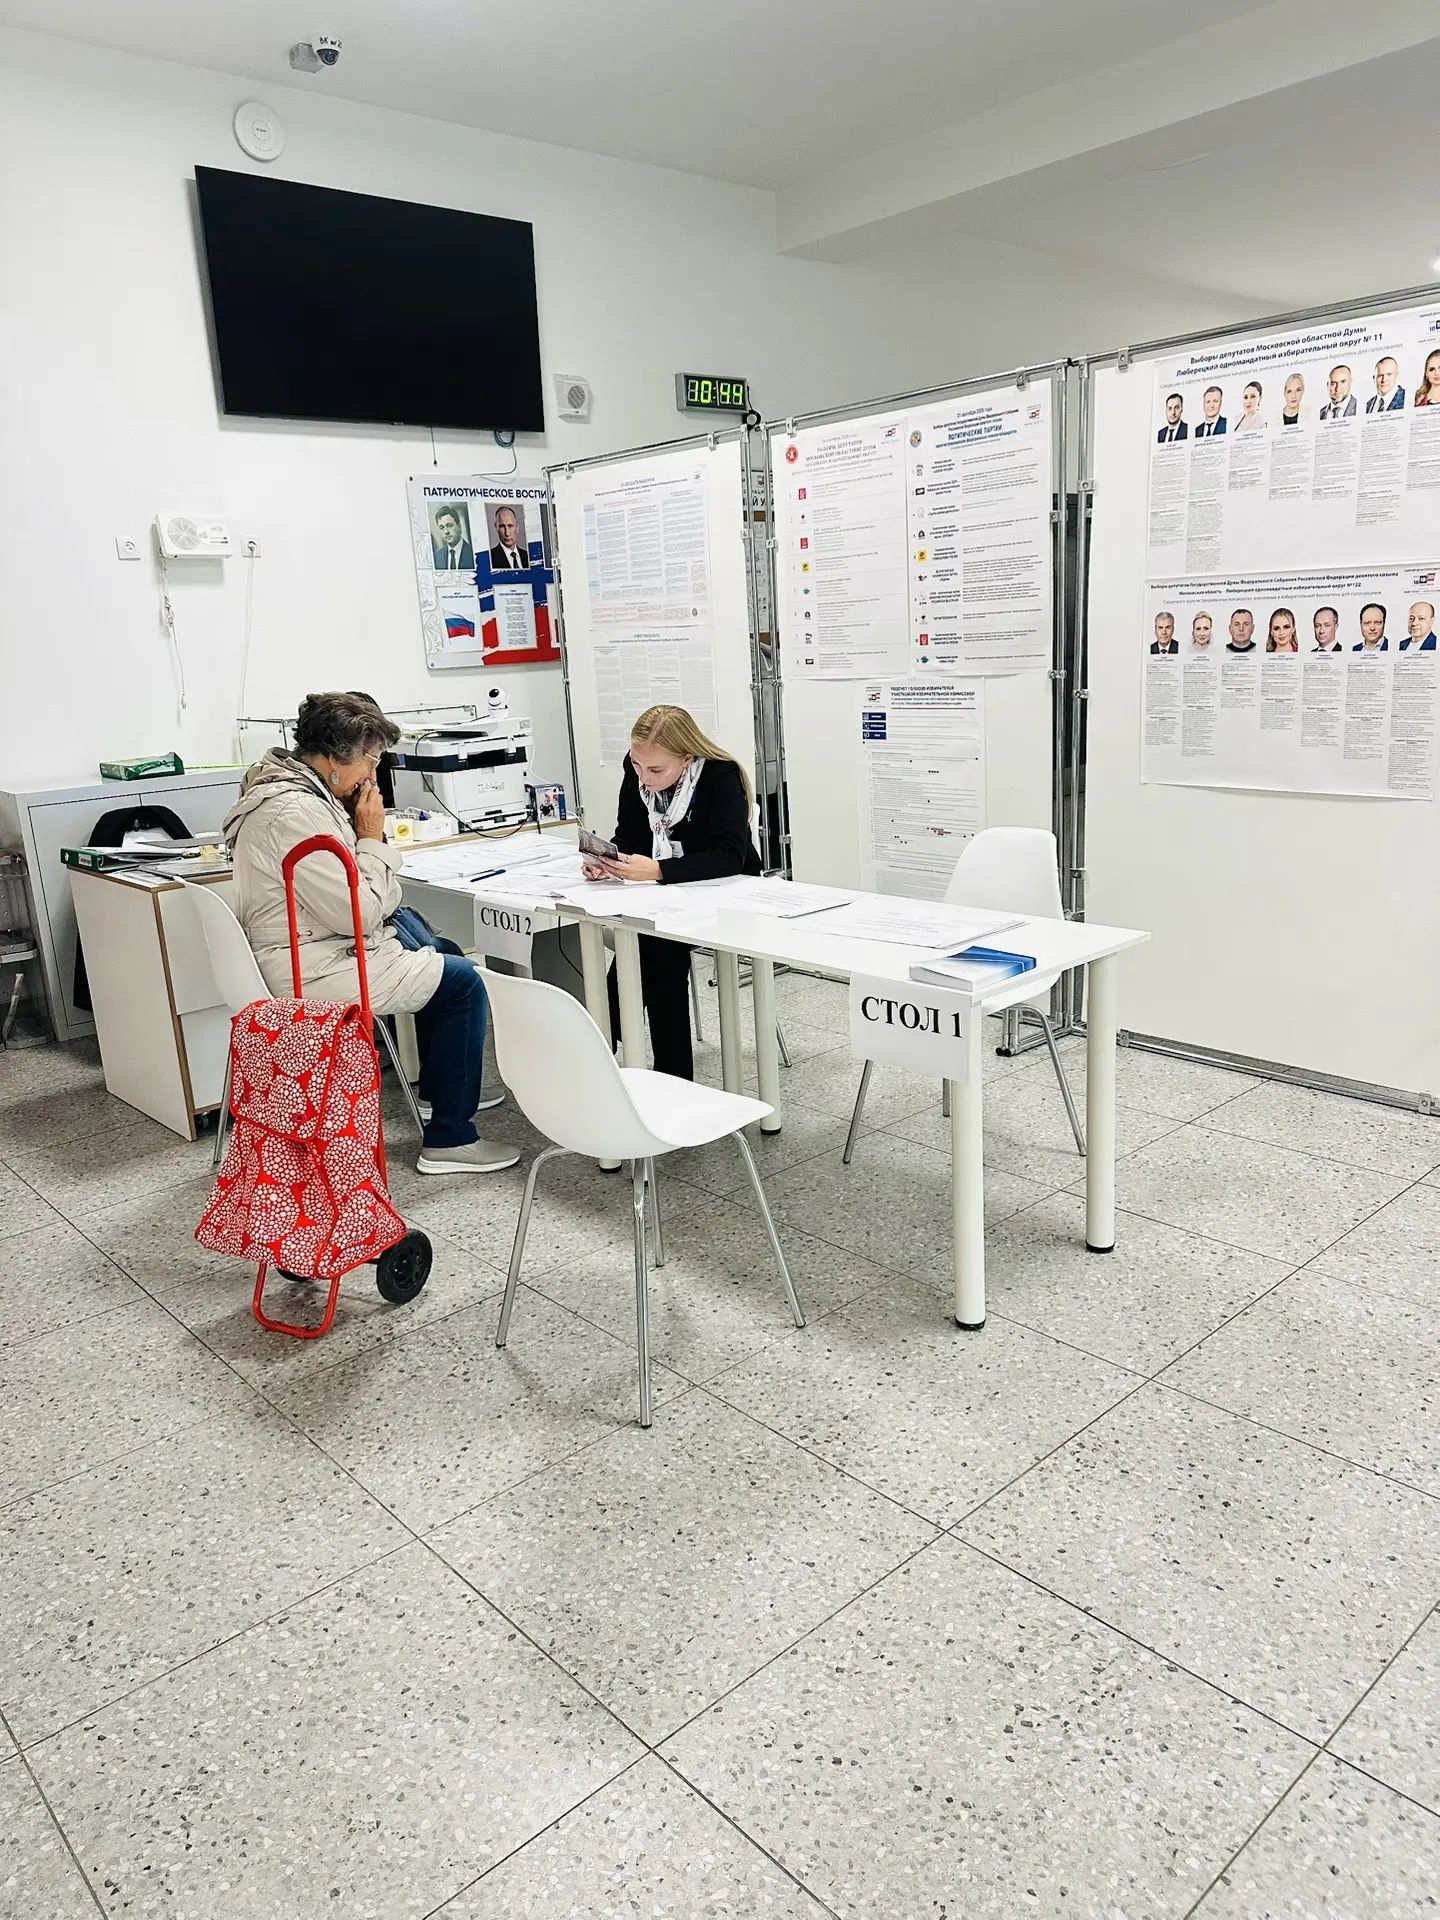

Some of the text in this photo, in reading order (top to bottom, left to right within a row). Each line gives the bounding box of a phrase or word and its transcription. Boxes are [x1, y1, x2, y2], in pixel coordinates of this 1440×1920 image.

[1176, 362, 1219, 377] Люберецкий
[1219, 351, 1277, 369] одномандатный
[1277, 341, 1338, 358] избирательный
[1339, 337, 1362, 349] округ
[1374, 333, 1383, 341] 11
[1190, 326, 1367, 365] Выборы депутатов Московской областной Думы
[693, 379, 744, 406] 10:44
[423, 487, 555, 499] ПАТРИОТИЧЕСКОЕ ВОСПИ
[481, 906, 532, 936] СТОЛ 2
[861, 996, 963, 1038] СТОЛ 1
